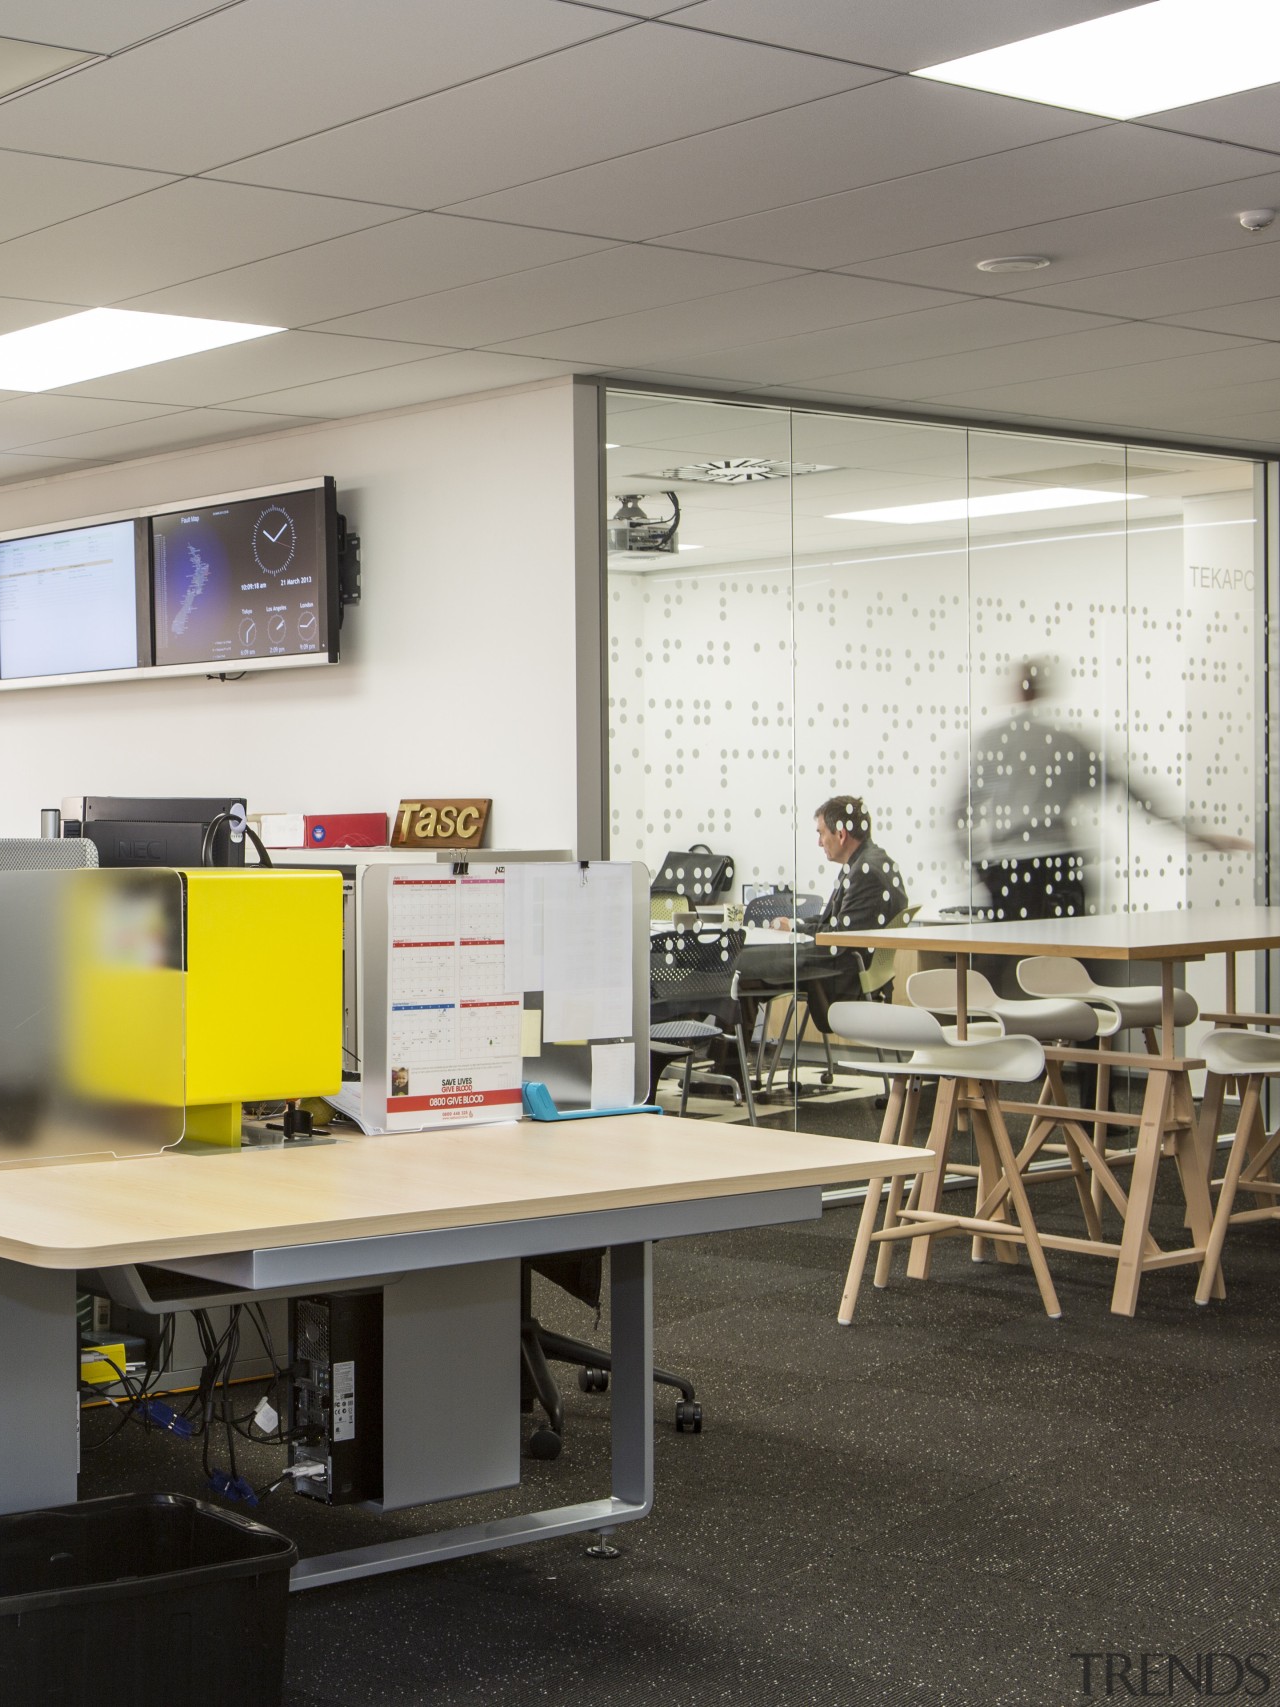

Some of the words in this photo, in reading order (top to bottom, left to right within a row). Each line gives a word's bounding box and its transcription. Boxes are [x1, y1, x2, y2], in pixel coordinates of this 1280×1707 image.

[287, 577, 300, 585] March
[301, 576, 312, 584] 2013
[273, 605, 287, 613] Angeles
[399, 802, 480, 843] Tasc
[119, 841, 161, 860] NEC
[458, 1077, 472, 1085] LIVES
[456, 1085, 472, 1093] BLOOD
[429, 1098, 445, 1107] 0800
[447, 1096, 463, 1105] GIVE
[463, 1094, 484, 1103] BLOOD
